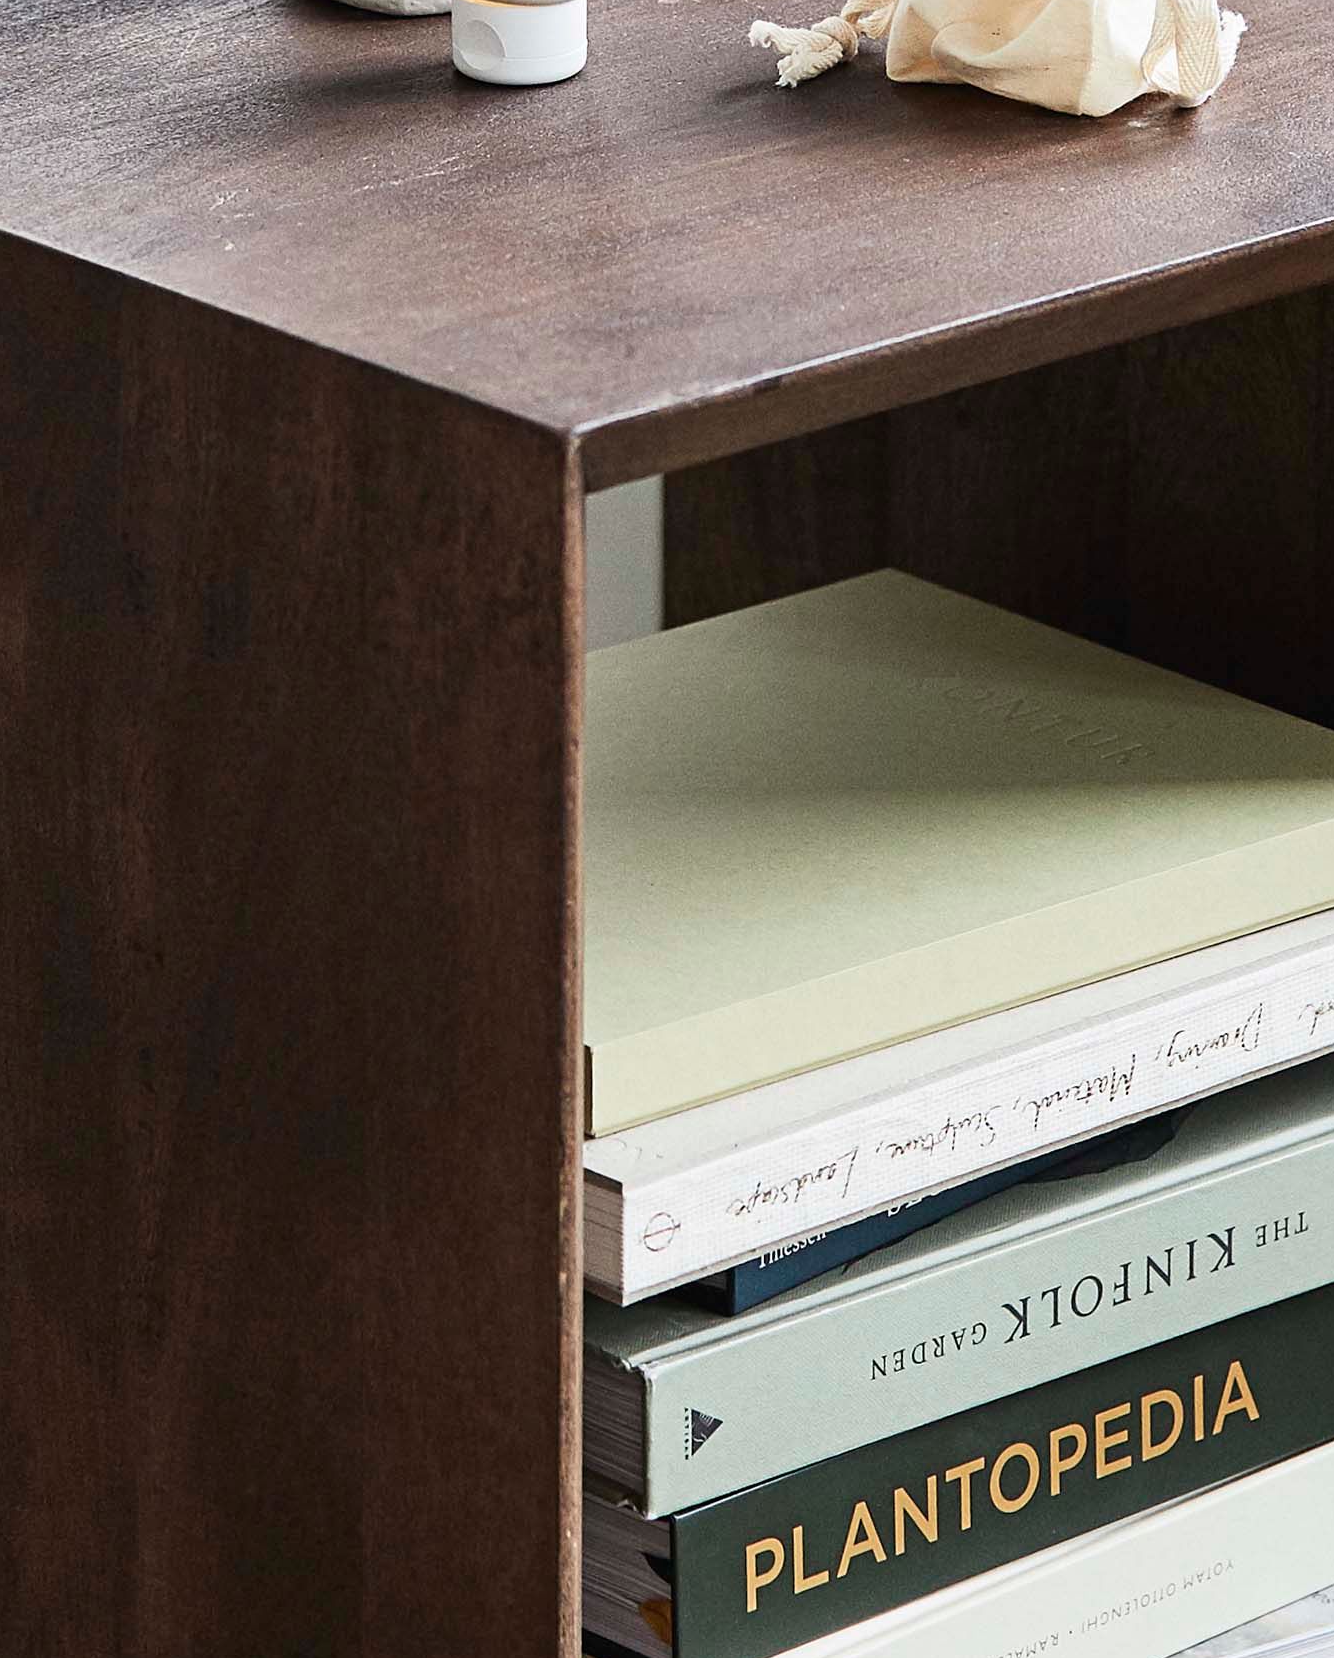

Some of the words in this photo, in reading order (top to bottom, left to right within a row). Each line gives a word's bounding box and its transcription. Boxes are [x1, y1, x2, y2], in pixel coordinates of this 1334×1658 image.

[1256, 1212, 1309, 1248] THE
[1001, 1226, 1237, 1346] KINFOLK
[870, 1322, 988, 1381] GARDEN
[745, 1359, 1261, 1613] PLANTOPEDIA
[1183, 1558, 1234, 1593] YOTAM
[1081, 1581, 1177, 1634] OTTOLENGHI
